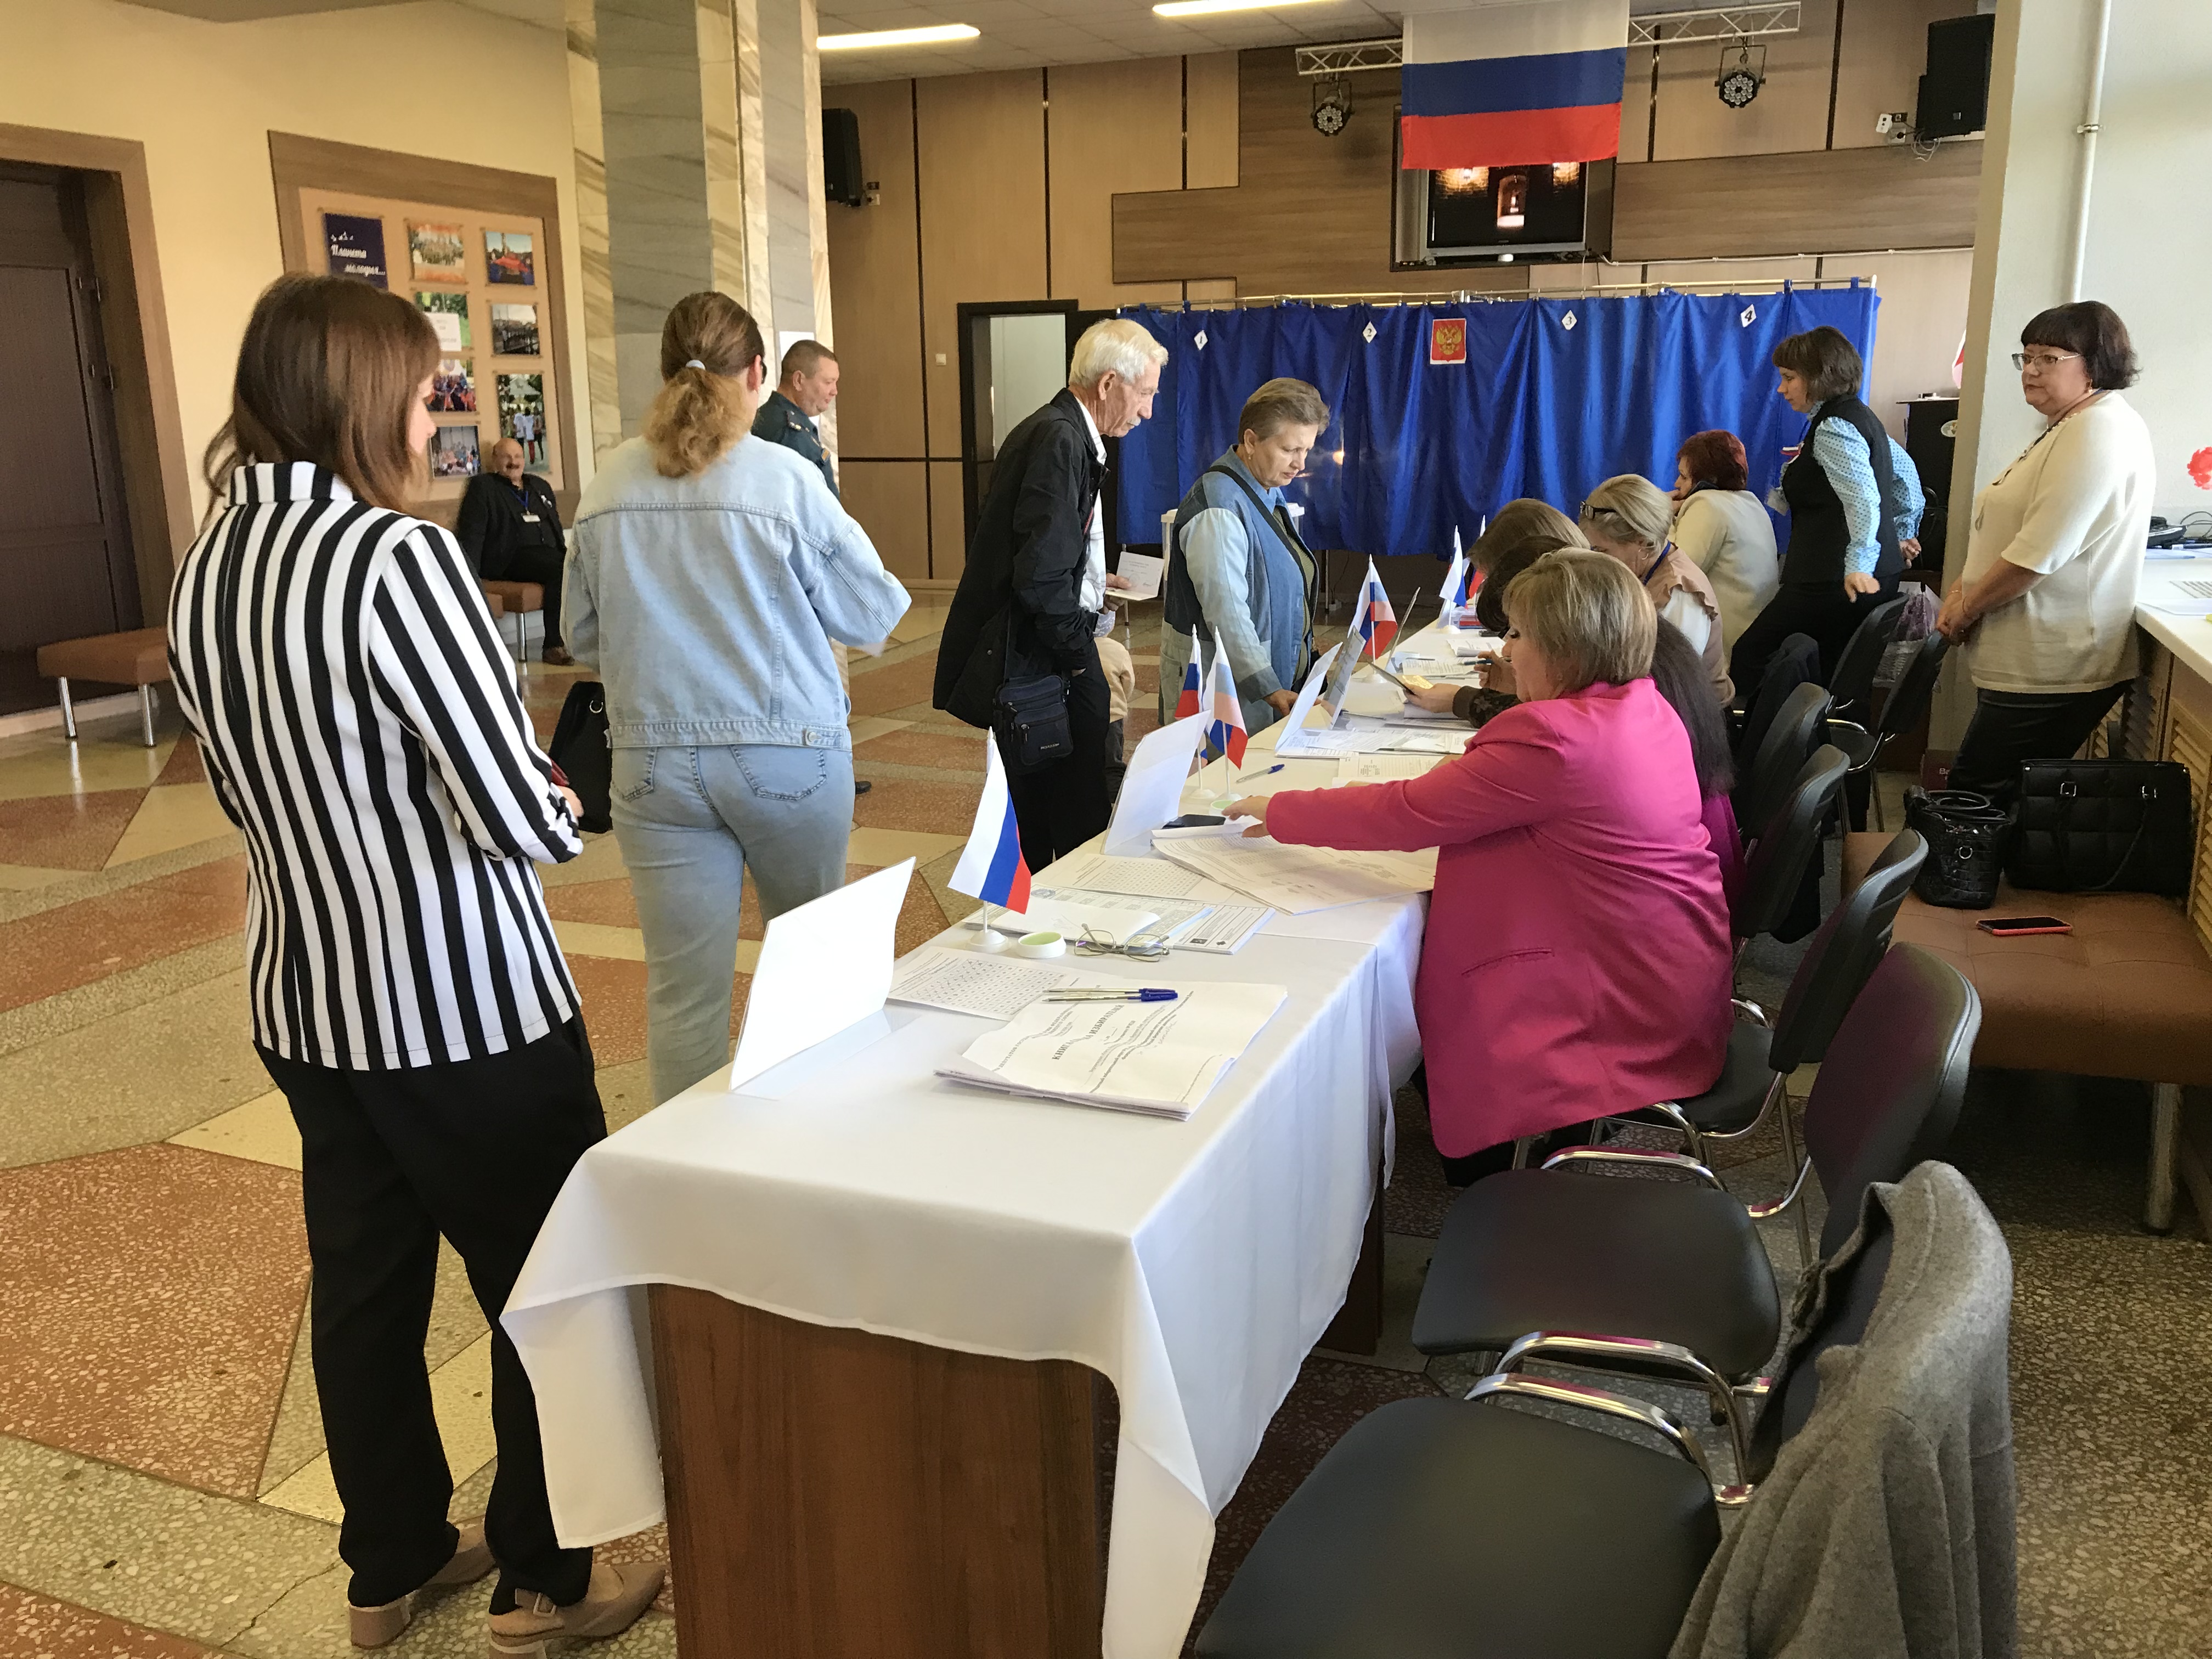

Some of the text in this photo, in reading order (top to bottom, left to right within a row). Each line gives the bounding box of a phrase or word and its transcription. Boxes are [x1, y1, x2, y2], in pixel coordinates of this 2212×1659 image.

[1566, 316, 1572, 325] 3
[1745, 310, 1753, 322] 4
[1367, 328, 1372, 337] 2
[1052, 1041, 1074, 1060] КНИГА
[1089, 1004, 1125, 1035] ИЗБИРАТЕЛЕЙ
